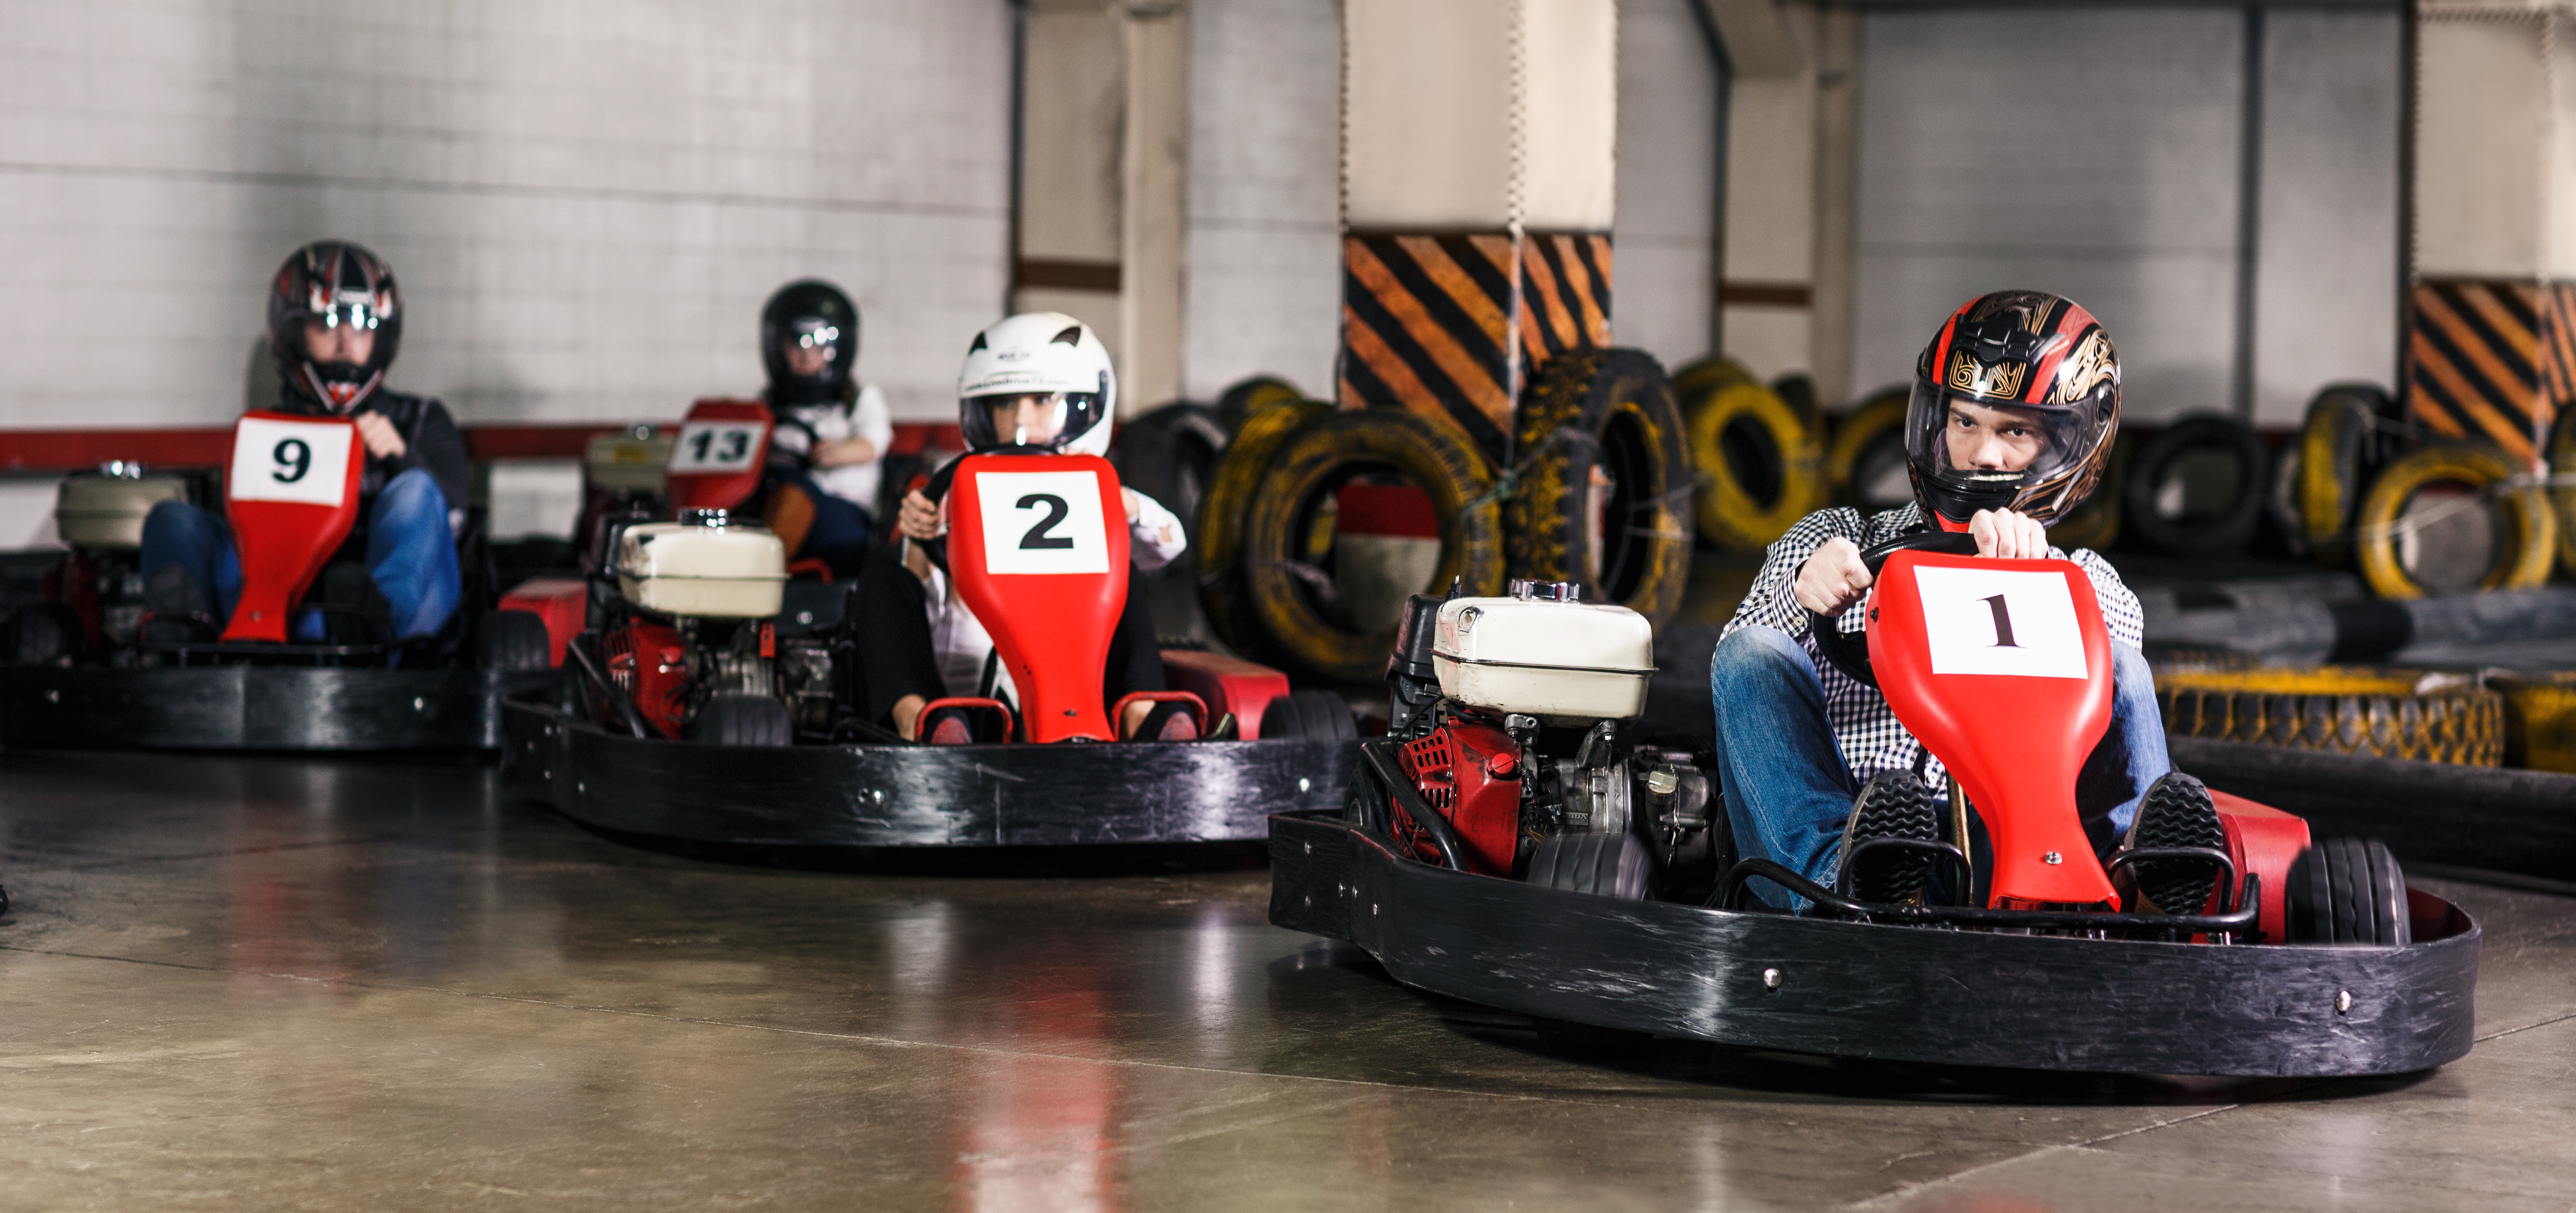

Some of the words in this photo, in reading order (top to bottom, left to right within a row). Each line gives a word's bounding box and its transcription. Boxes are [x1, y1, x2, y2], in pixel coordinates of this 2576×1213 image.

[271, 438, 311, 484] 9
[690, 431, 750, 462] 13
[1015, 493, 1074, 549] 2
[1977, 594, 2027, 648] 1
